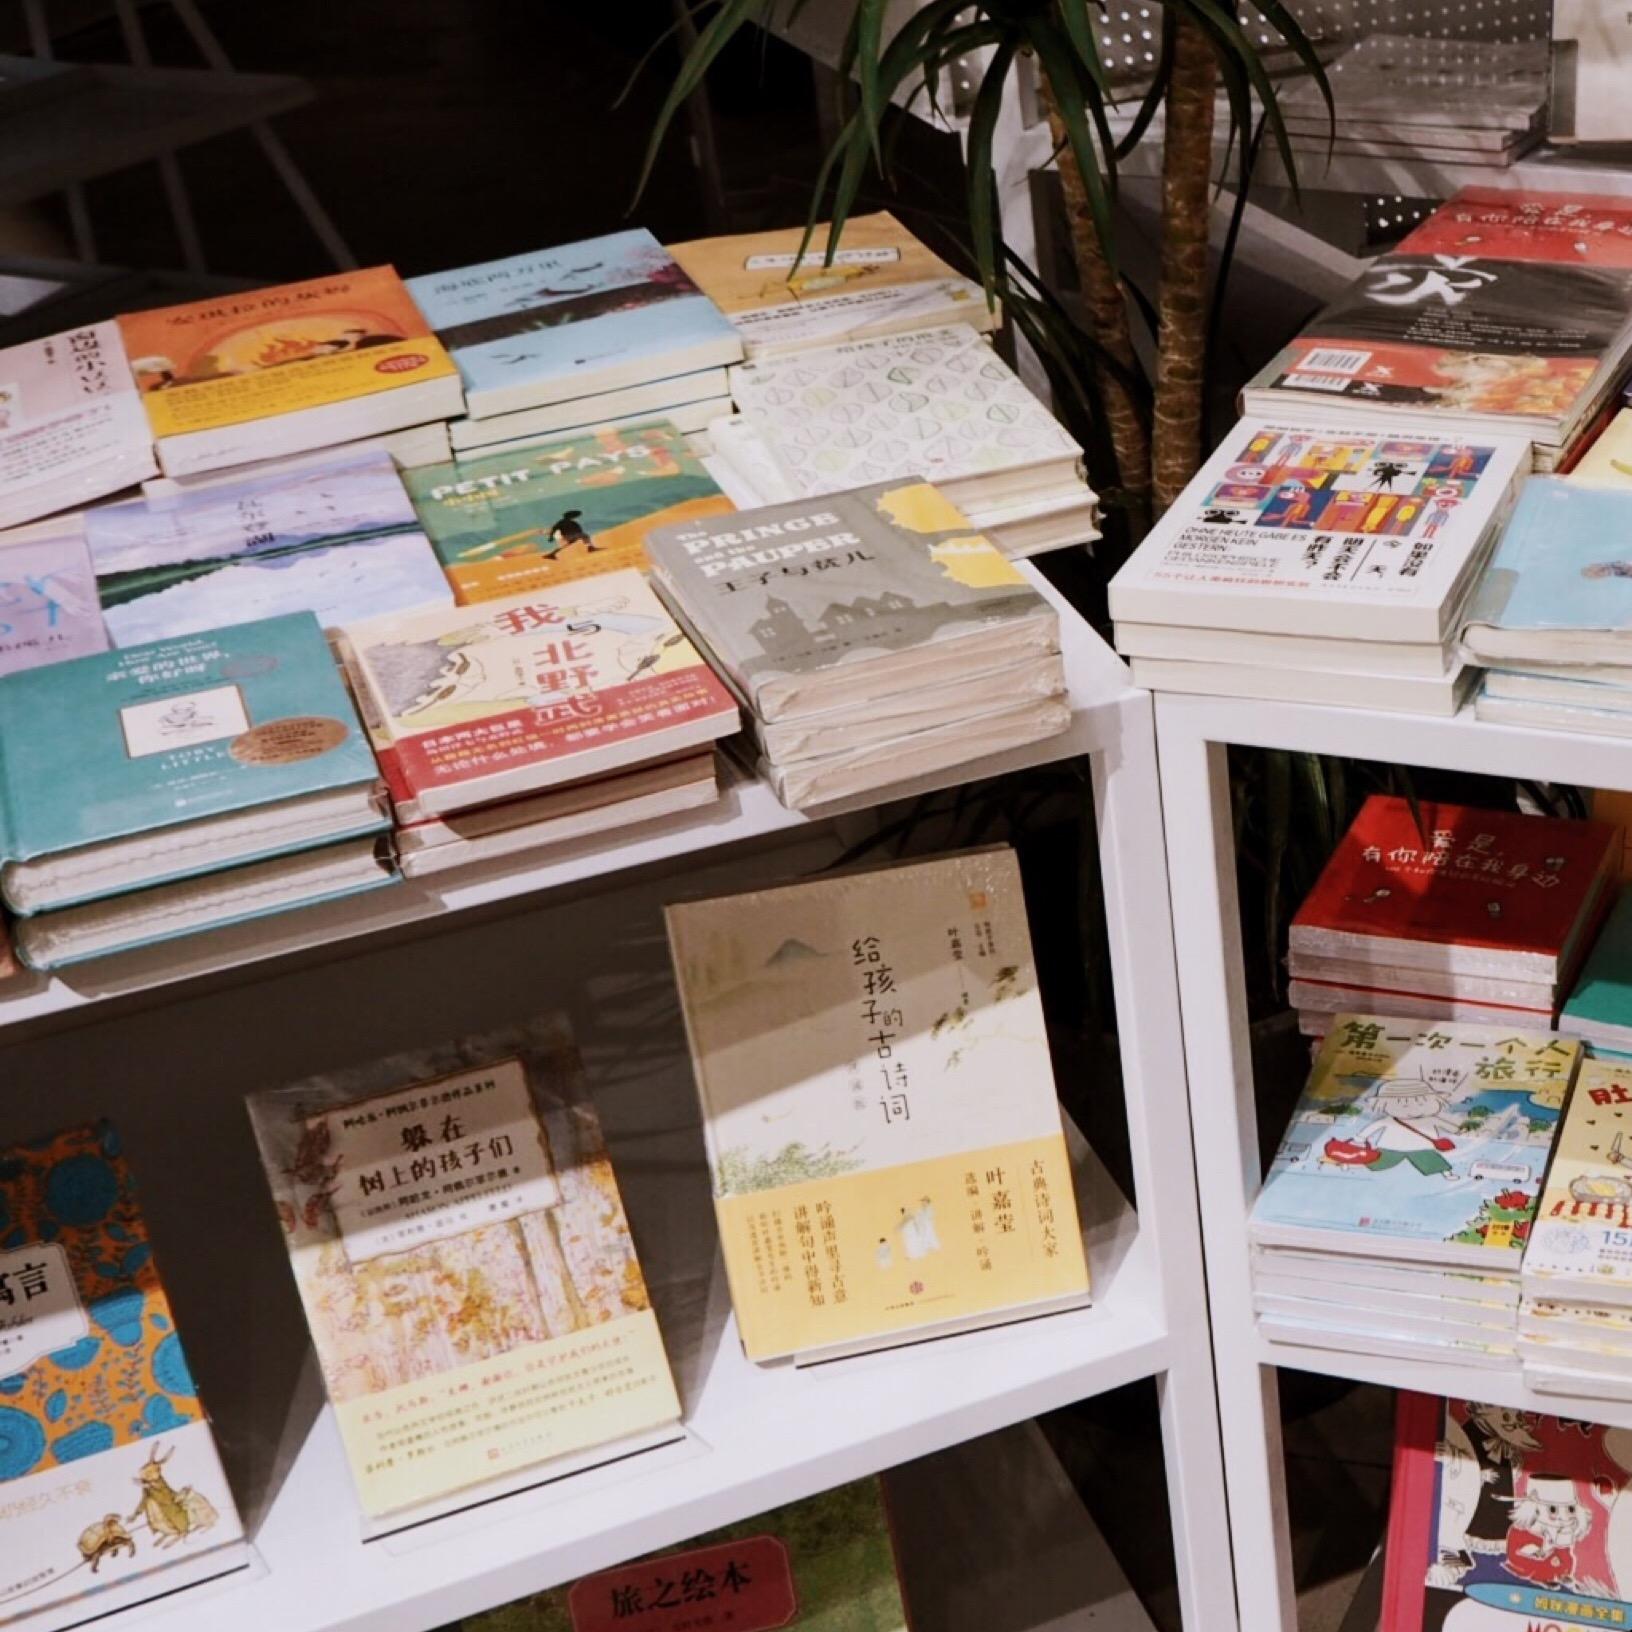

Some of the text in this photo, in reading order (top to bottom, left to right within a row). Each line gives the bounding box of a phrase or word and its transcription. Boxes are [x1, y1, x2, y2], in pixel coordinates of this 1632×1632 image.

[429, 444, 651, 502] PETIT PAYS
[851, 934, 912, 1126] 给孩子的古诗词
[1340, 1018, 1576, 1058] 第一次一个人
[1471, 1056, 1564, 1083] 旅行
[400, 1113, 469, 1154] 躲在
[358, 1134, 515, 1198] 树上的孩子们
[985, 1165, 1018, 1236] 叶嘉莹
[609, 1559, 754, 1620] 旅之绘本
